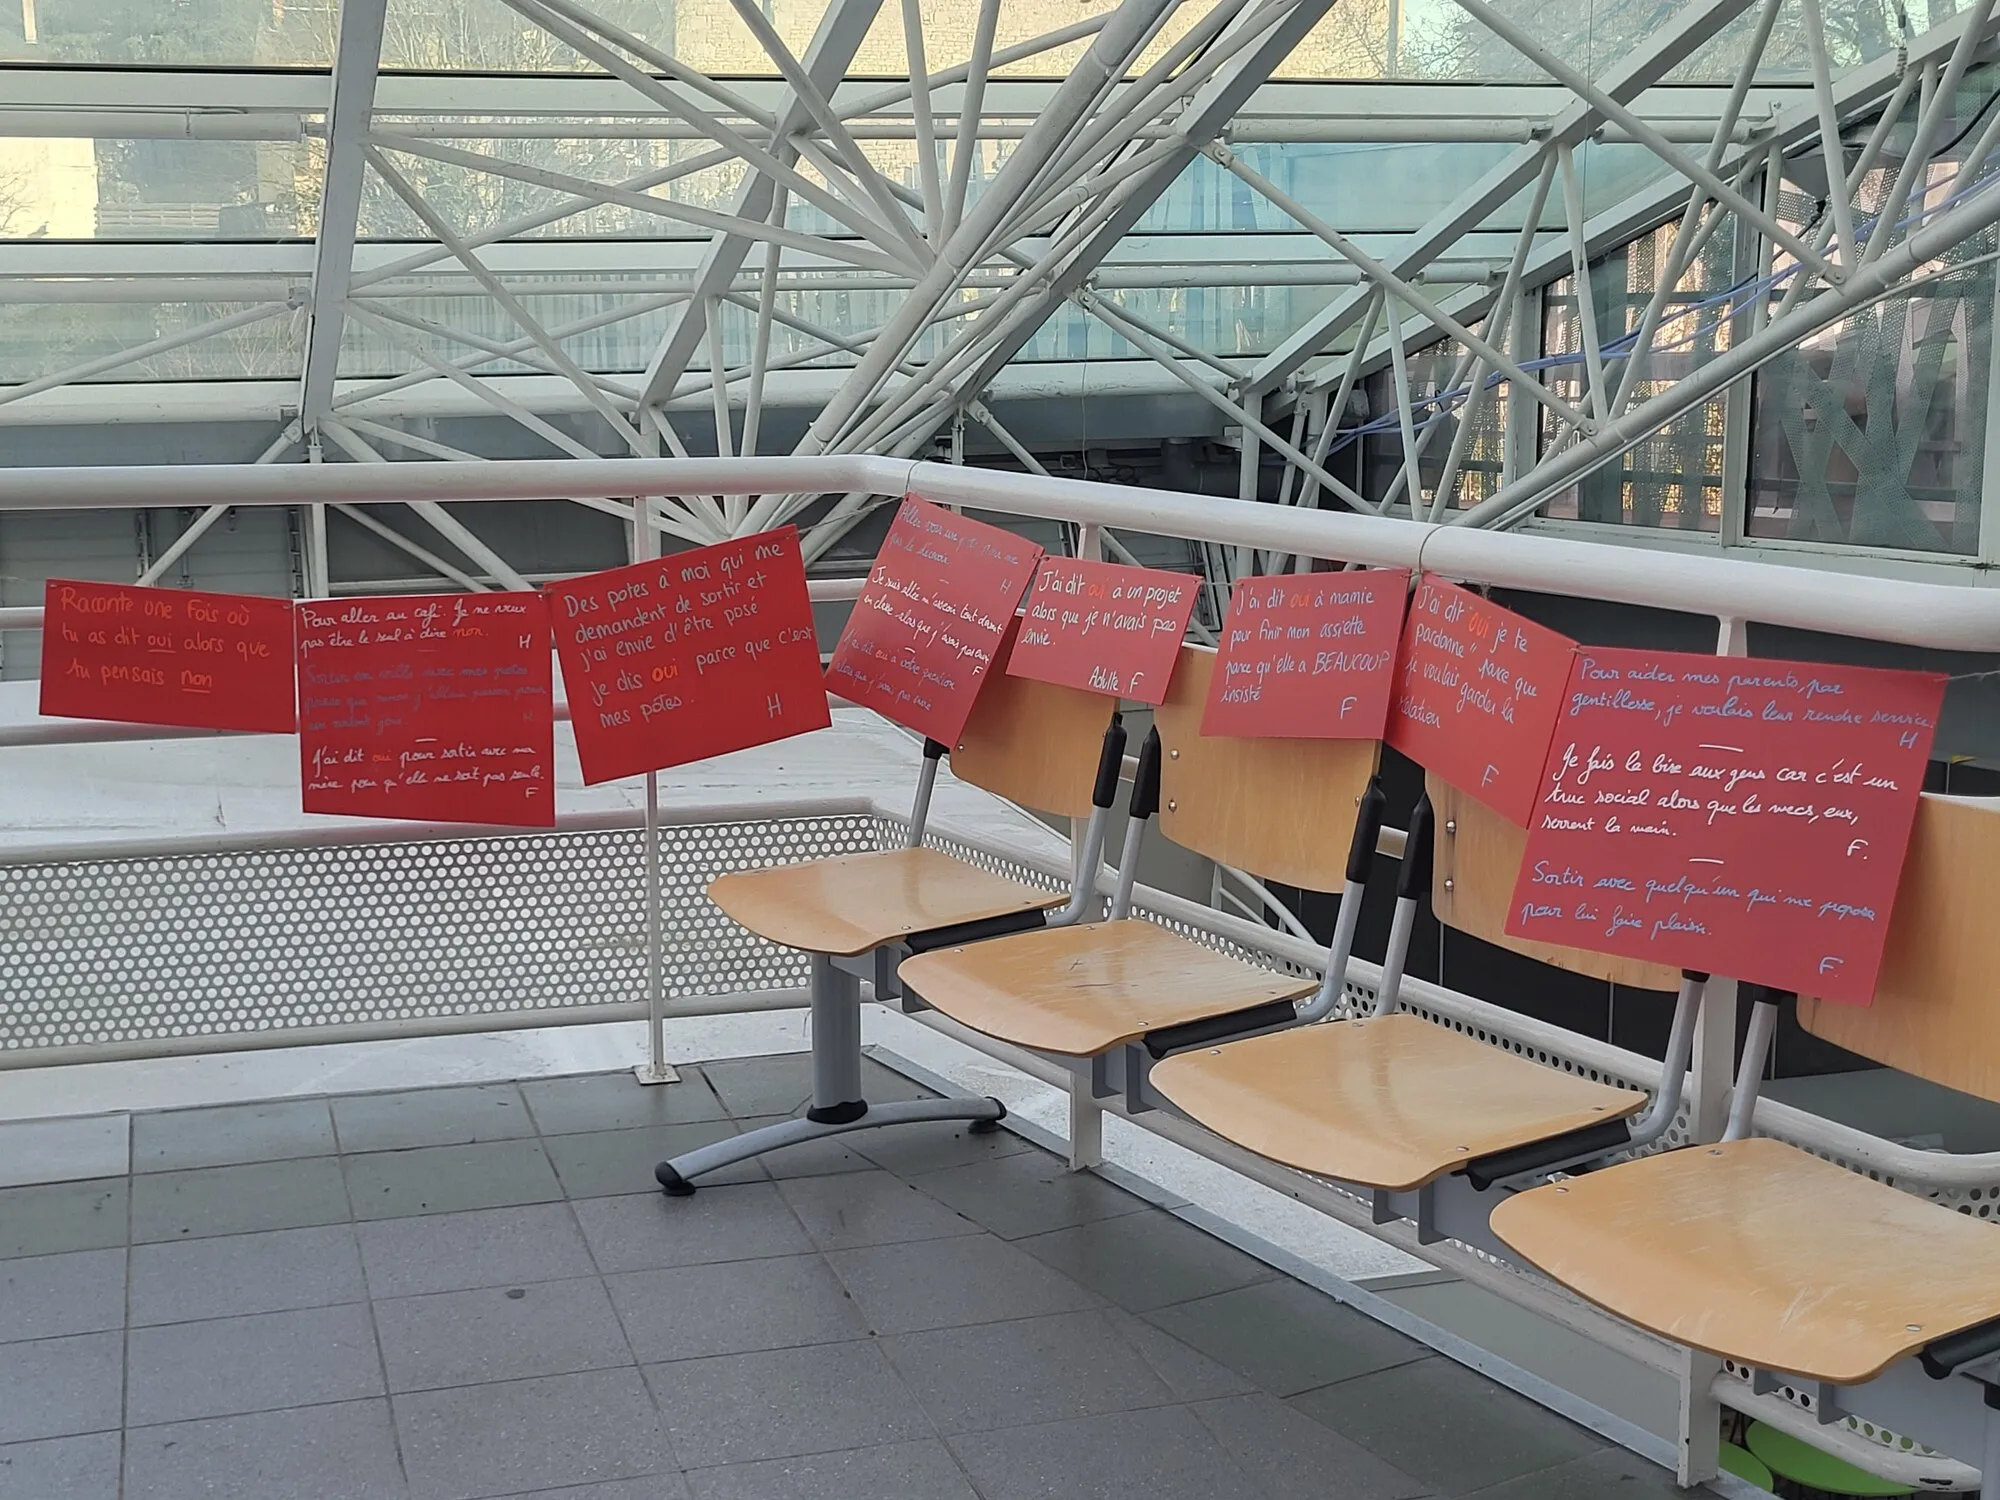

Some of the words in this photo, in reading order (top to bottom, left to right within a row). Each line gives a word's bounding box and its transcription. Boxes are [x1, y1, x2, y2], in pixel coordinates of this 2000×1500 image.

[564, 595, 599, 618] Des
[607, 582, 650, 612] potes
[658, 568, 671, 590] à
[680, 561, 710, 583] moi
[721, 548, 744, 579] qui
[755, 542, 785, 562] me
[872, 566, 886, 585] Je
[884, 578, 901, 592] suis
[901, 579, 920, 602] allée
[960, 603, 979, 623] tout
[999, 578, 1012, 594] H
[1038, 569, 1063, 593] J'ai
[1065, 572, 1085, 595] dit
[1087, 577, 1106, 597] oui
[1112, 578, 1125, 598] à
[1127, 586, 1142, 599] un
[1144, 584, 1182, 609] projet
[60, 587, 134, 613] Raconte
[144, 602, 173, 619] une
[226, 605, 250, 626] où
[302, 608, 337, 629] Pour
[341, 606, 380, 624] aller
[386, 611, 408, 621] au
[453, 598, 469, 627] Je
[473, 606, 491, 615] ne
[493, 604, 527, 614] veux
[576, 603, 667, 645] demandent
[675, 597, 693, 615] de
[701, 582, 741, 607] sortir
[747, 571, 768, 590] et
[1267, 588, 1285, 608] dit
[1290, 589, 1311, 608] oui
[1314, 589, 1324, 608] à
[1330, 587, 1374, 604] mamie
[581, 646, 608, 673] j'ai
[616, 635, 656, 656] envie
[664, 615, 714, 644] d'être
[724, 596, 759, 627] posé
[1031, 601, 1057, 621] alors
[1062, 611, 1079, 630] que
[1082, 606, 1099, 635] je
[1103, 609, 1147, 631] n'avais
[1150, 618, 1177, 639] pas
[1230, 628, 1252, 652] pour
[1259, 618, 1282, 641] finir
[1319, 615, 1366, 638] assiette
[1417, 584, 1441, 615] J'ai
[1444, 595, 1465, 624] dit
[1489, 621, 1507, 654] je
[1514, 627, 1528, 653] te
[62, 623, 79, 643] tu
[88, 629, 106, 644] as
[114, 627, 140, 645] dit
[148, 633, 173, 649] oui
[184, 632, 225, 653] alors
[236, 641, 271, 661] que
[300, 639, 325, 659] pas
[329, 629, 354, 647] être
[358, 629, 369, 644] le
[375, 628, 400, 642] seul
[404, 628, 416, 640] à
[419, 627, 447, 639] dire
[452, 627, 489, 638] non.
[519, 634, 532, 649] H
[913, 621, 932, 640] que
[956, 644, 976, 660] pas
[1021, 627, 1056, 646] envie.
[66, 658, 90, 679] tu
[101, 666, 165, 685] pensais
[181, 670, 213, 688] non
[616, 669, 644, 692] dis
[651, 658, 678, 682] oui
[696, 646, 736, 675] parce
[745, 640, 771, 661] que
[971, 666, 984, 676] F
[1225, 662, 1252, 685] parce
[1256, 653, 1295, 684] qu'elle
[1298, 660, 1306, 673] a
[1312, 650, 1391, 675] BEAUCOUP
[1478, 658, 1510, 685] parce
[1514, 677, 1538, 700] que
[1580, 658, 1620, 682] Pour
[1627, 663, 1675, 682] aider
[1681, 672, 1720, 684] mes
[1806, 681, 1845, 698] par
[1129, 672, 1145, 694] F
[1220, 685, 1263, 702] insisté
[1404, 652, 1417, 687] je
[1423, 660, 1460, 688] voulais
[1455, 681, 1497, 713] garder
[1501, 696, 1514, 725] la
[600, 709, 631, 728] mes
[767, 692, 782, 719] H
[1340, 696, 1358, 720] F
[1399, 696, 1441, 729] relation
[1662, 701, 1683, 727] je
[1691, 697, 1754, 719] voulais
[1761, 700, 1794, 723] leur
[1802, 705, 1863, 725] rendre
[1899, 731, 1919, 749] H
[343, 749, 364, 764] dit
[372, 752, 392, 762] oui
[399, 751, 436, 768] pour
[480, 745, 506, 756] avec
[512, 745, 536, 754] ma
[1554, 743, 1578, 782] Je
[1577, 753, 1615, 785] fais
[1652, 754, 1682, 776] bise
[1689, 763, 1727, 779] aux
[1728, 767, 1766, 792] gens
[1776, 766, 1808, 783] car
[1815, 758, 1864, 785] c'est
[1863, 777, 1901, 791] un
[351, 778, 378, 793] pour
[433, 773, 451, 783] ne
[482, 772, 506, 787] pas
[1480, 764, 1500, 788] F
[525, 787, 539, 798] F
[1544, 784, 1586, 805] truc
[1594, 789, 1650, 807] social
[1656, 790, 1700, 810] alors
[1707, 800, 1738, 826] que
[1741, 794, 1762, 814] les
[1822, 807, 1859, 826] eux,
[1541, 813, 1595, 831] serrent
[1604, 817, 1622, 834] la
[1629, 822, 1677, 837] main.
[1847, 839, 1868, 860] F.
[1532, 860, 1586, 887] Sortir
[1593, 878, 1637, 891] avec
[1645, 875, 1742, 904] quelqu'un
[1746, 888, 1782, 913] qui
[1782, 895, 1812, 908] me
[1521, 903, 1563, 925] pour
[1574, 904, 1599, 921] lui
[1605, 906, 1643, 936] faire
